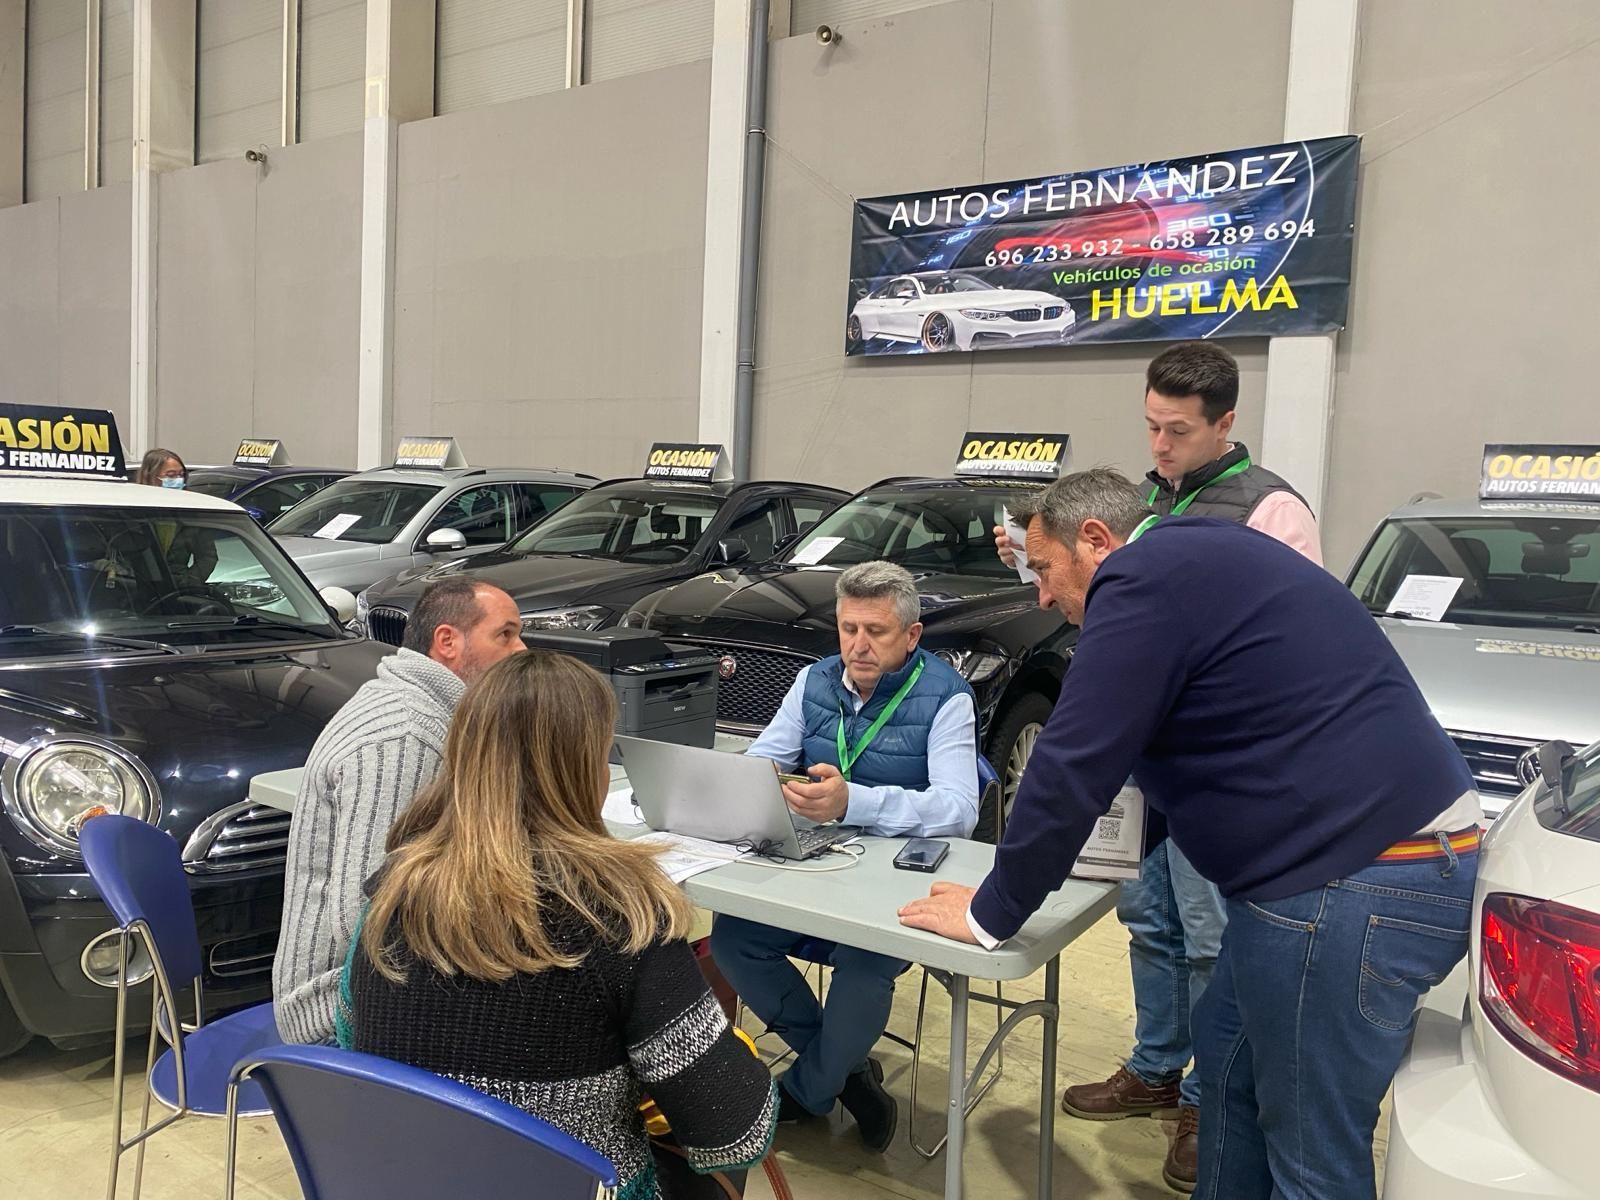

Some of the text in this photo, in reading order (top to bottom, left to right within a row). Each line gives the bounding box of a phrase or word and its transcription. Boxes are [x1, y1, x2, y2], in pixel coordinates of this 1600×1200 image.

[887, 150, 1299, 230] AUTOS FERNÁNDEZ
[1168, 213, 1232, 232] 360
[984, 248, 1025, 267] 696
[1032, 243, 1072, 263] 233
[1081, 238, 1124, 258] 932
[1150, 230, 1196, 251] 658
[1206, 224, 1254, 247] 289
[1264, 219, 1316, 241] 694
[1053, 255, 1256, 285] Vehículos de ocasión
[1091, 274, 1299, 321] HUELMA
[9, 450, 116, 471] FERNANDEZ
[650, 447, 716, 467] OCASIÓN
[963, 438, 1062, 462] OCASIÓN
[647, 466, 712, 477] AUTOS FERNANDEZ
[994, 461, 1058, 473] FERNANDEZ
[1487, 479, 1538, 492] AUTOS
